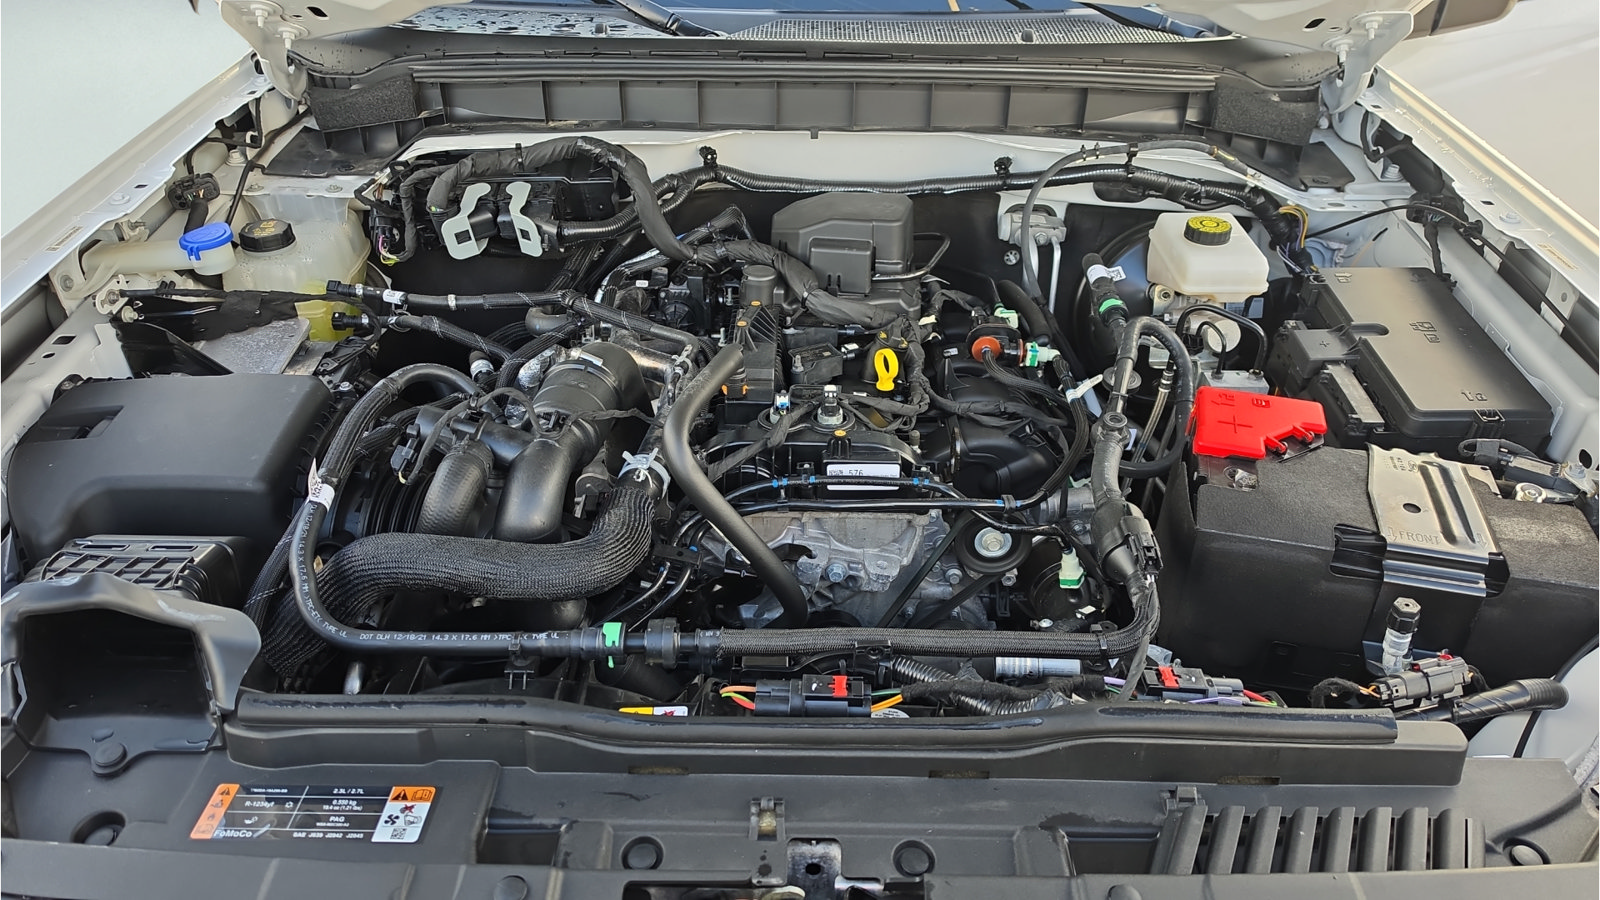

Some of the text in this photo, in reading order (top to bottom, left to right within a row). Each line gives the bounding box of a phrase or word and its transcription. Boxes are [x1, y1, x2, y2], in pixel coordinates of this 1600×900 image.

[1399, 530, 1441, 546] FRONT
[299, 565, 308, 580] 17.6
[339, 630, 348, 638] UL
[393, 633, 427, 641] 12/18/21
[431, 633, 450, 641] 14.3
[532, 631, 549, 640] TYPE
[550, 631, 560, 639] UL
[329, 815, 346, 823] PAG
[213, 829, 253, 838] FoMoCo
